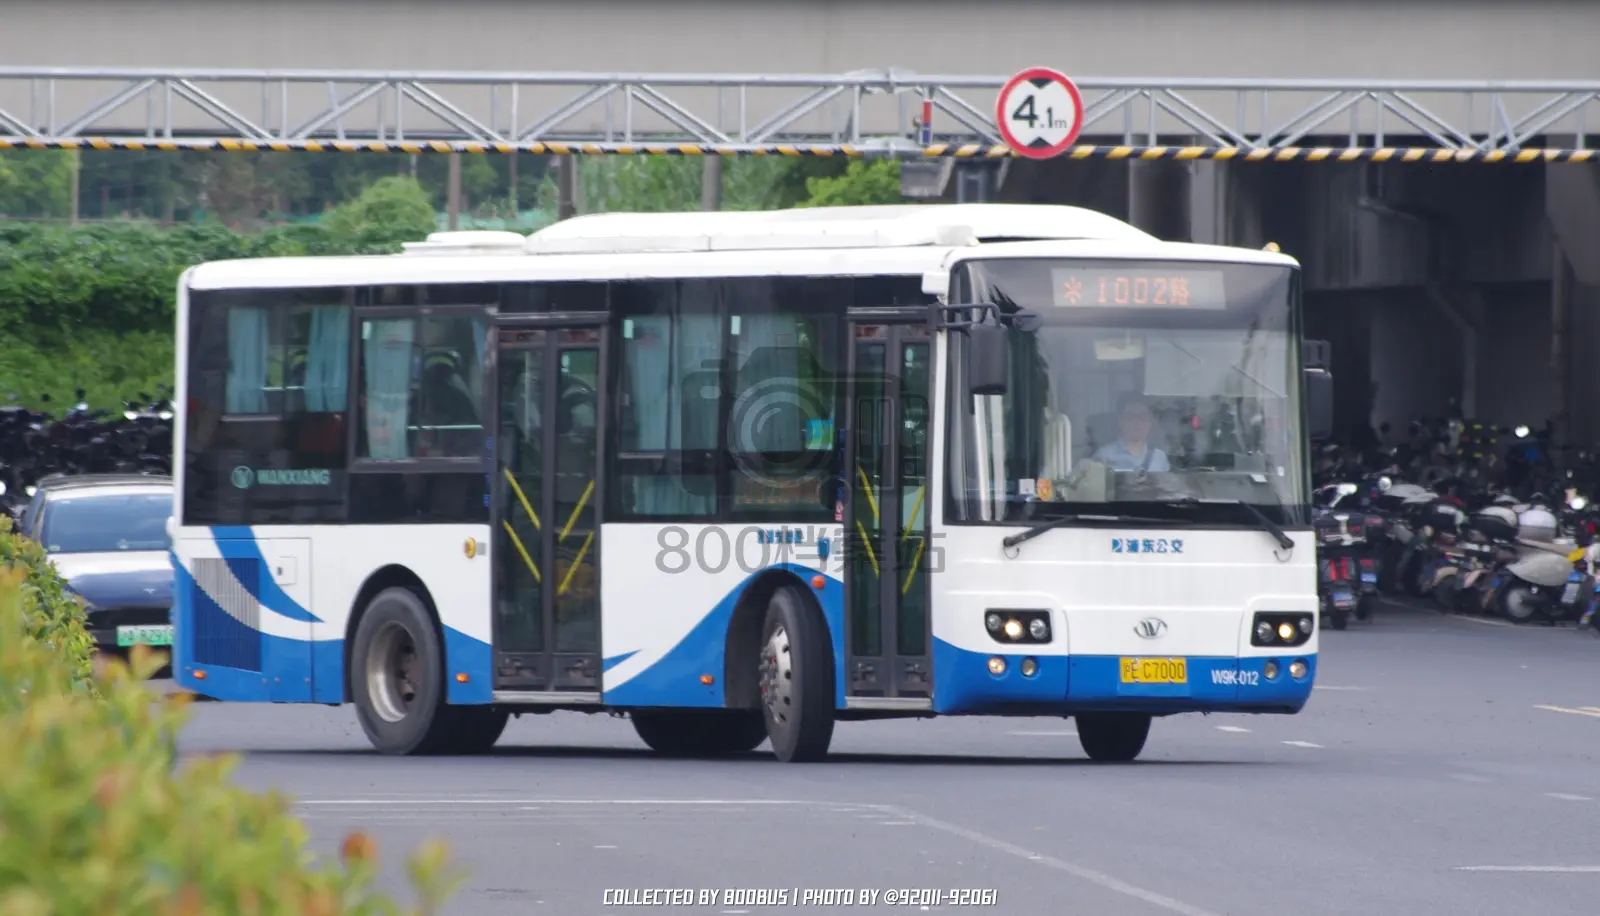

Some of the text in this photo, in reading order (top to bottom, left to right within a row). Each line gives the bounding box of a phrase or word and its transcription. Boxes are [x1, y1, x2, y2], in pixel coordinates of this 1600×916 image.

[1012, 95, 1067, 128] 4.1m
[257, 469, 330, 484] WANXIANG
[1127, 537, 1184, 554] 浦东公交
[1211, 669, 1260, 686] W9K-012
